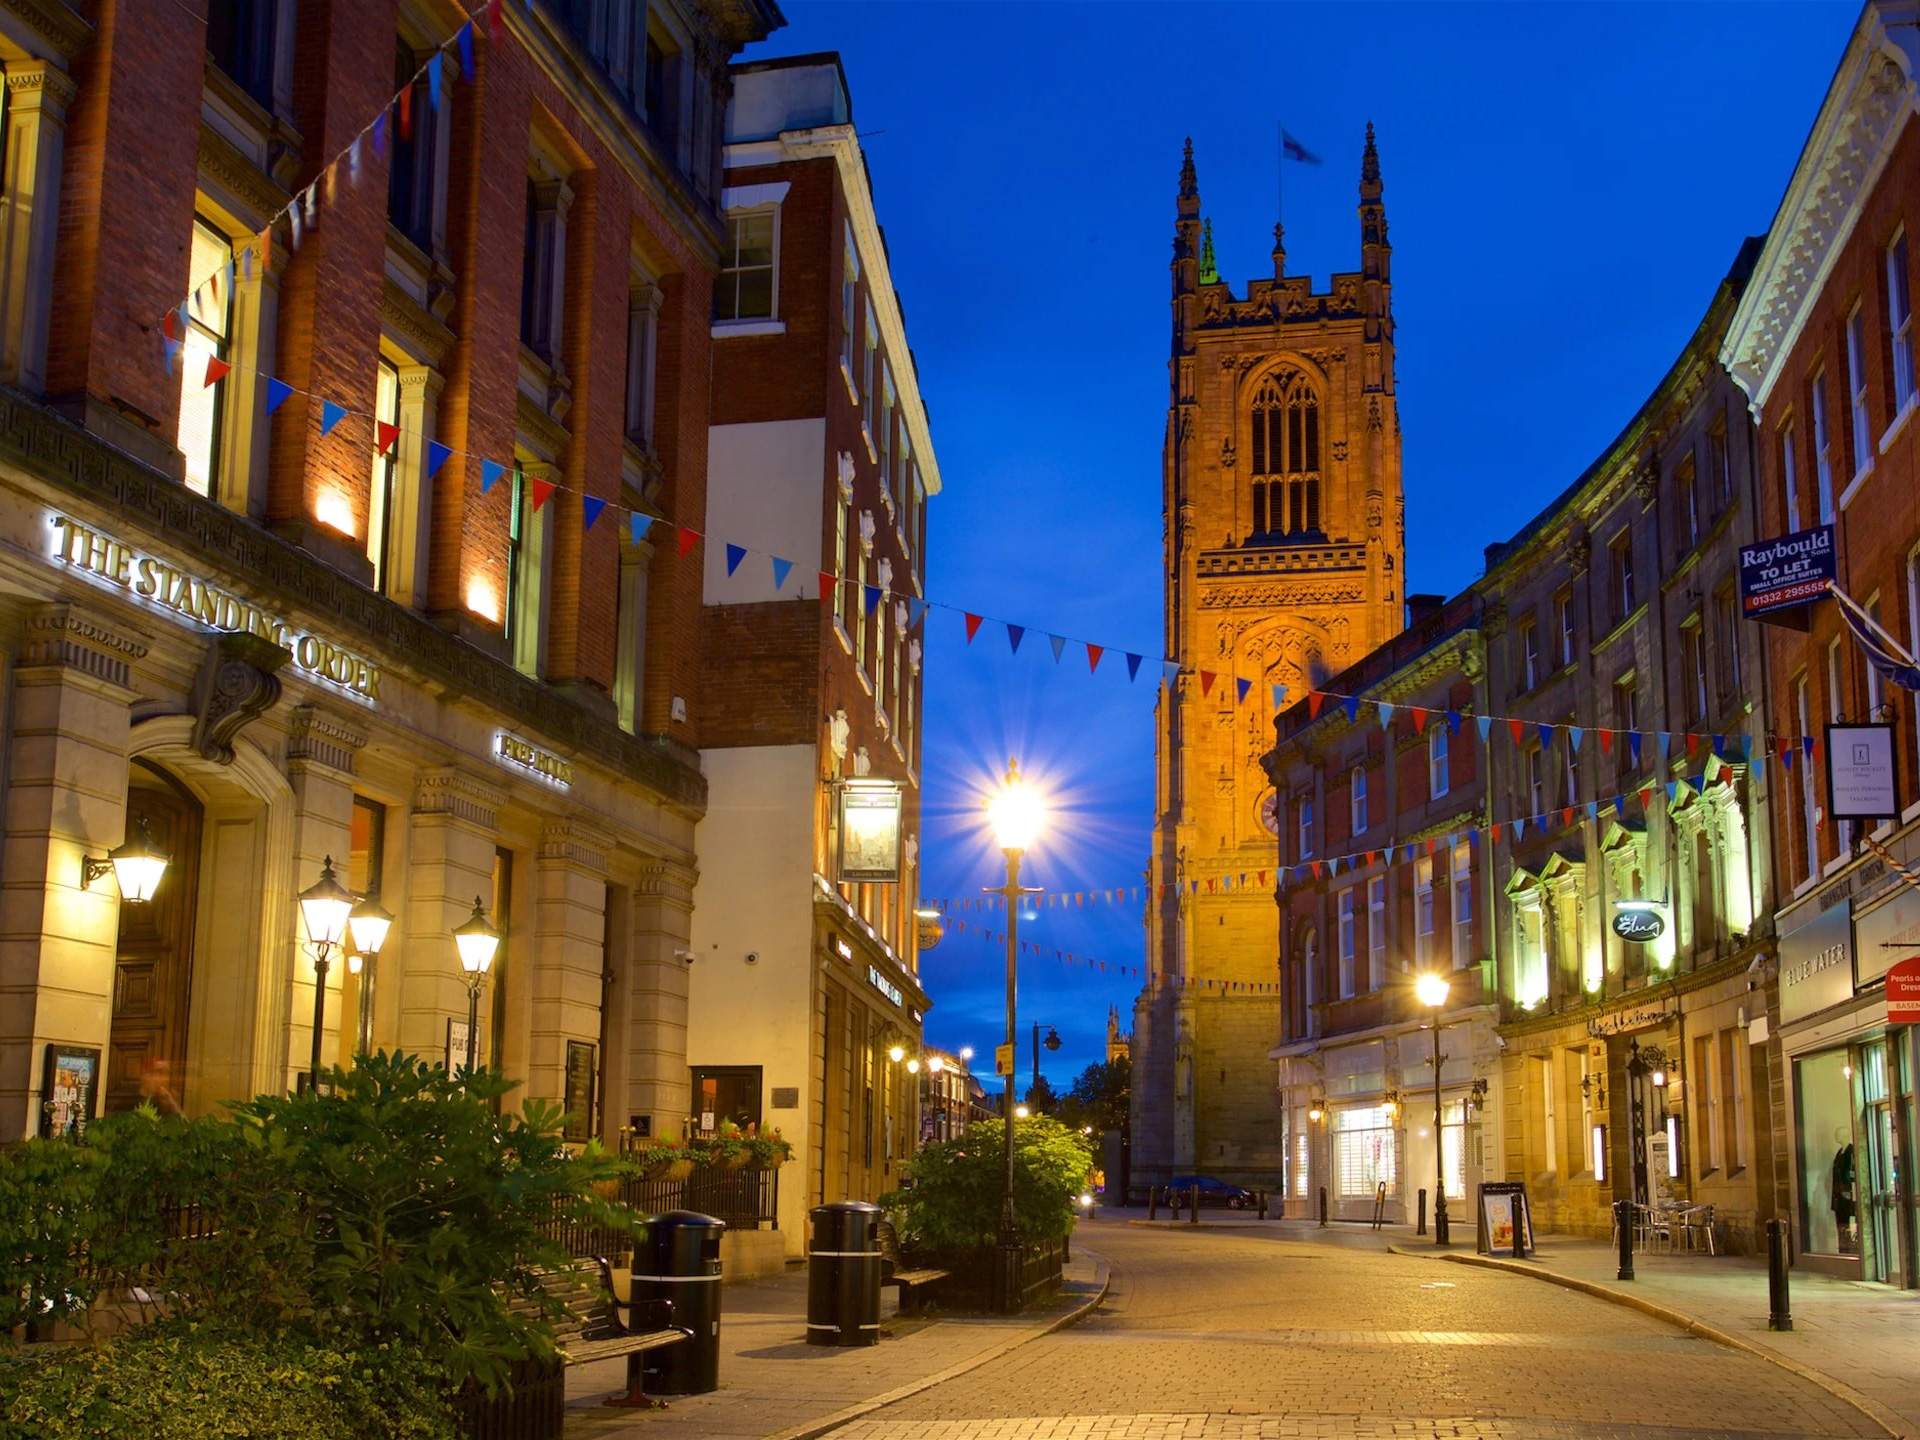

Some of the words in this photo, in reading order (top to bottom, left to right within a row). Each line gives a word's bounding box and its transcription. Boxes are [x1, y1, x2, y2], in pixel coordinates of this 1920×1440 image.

[1742, 530, 1830, 568] Raybould
[1800, 552, 1808, 560] &
[1810, 548, 1831, 558] Sons
[1750, 579, 1772, 591] SMALL
[1772, 573, 1796, 586] OFFICE
[1797, 567, 1823, 578] SUITES
[1759, 567, 1780, 581] TO
[1783, 559, 1811, 574] LET
[1752, 591, 1782, 606] 01332
[1784, 581, 1825, 598] 295555
[54, 516, 133, 586] THE
[136, 558, 294, 651] STANDING
[297, 635, 382, 702] ORDER
[1785, 959, 1811, 987] BLUE
[1811, 943, 1845, 975] WATER
[1890, 974, 1914, 983] Pearls
